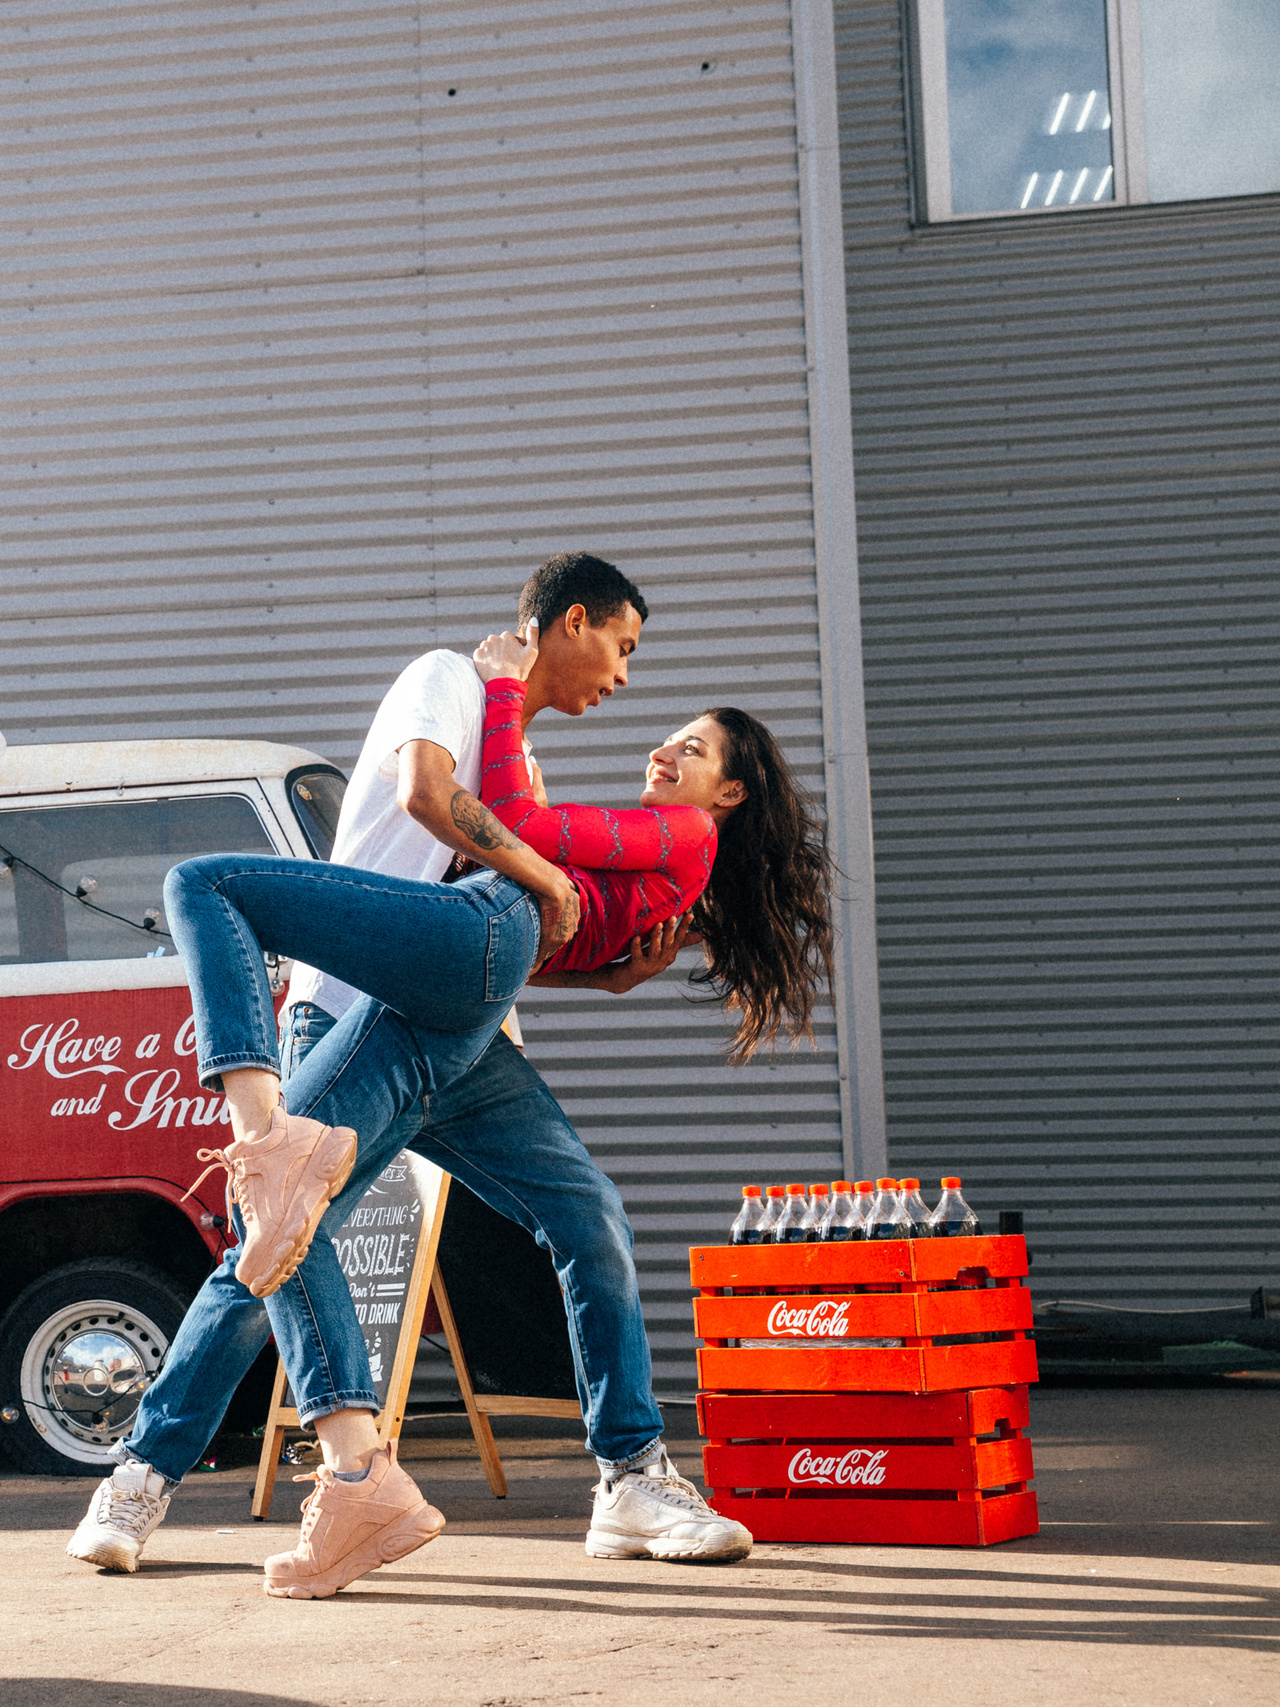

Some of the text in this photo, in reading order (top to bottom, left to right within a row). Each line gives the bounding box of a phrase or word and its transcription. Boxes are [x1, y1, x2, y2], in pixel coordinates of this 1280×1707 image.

[7, 1018, 128, 1079] Have
[135, 1033, 161, 1059] a
[50, 1084, 107, 1117] and
[349, 1282, 376, 1298] Don't
[354, 1302, 401, 1325] TO DRINK
[767, 1300, 852, 1337] Coca-Cola
[787, 1448, 890, 1486] Coca-Cola
